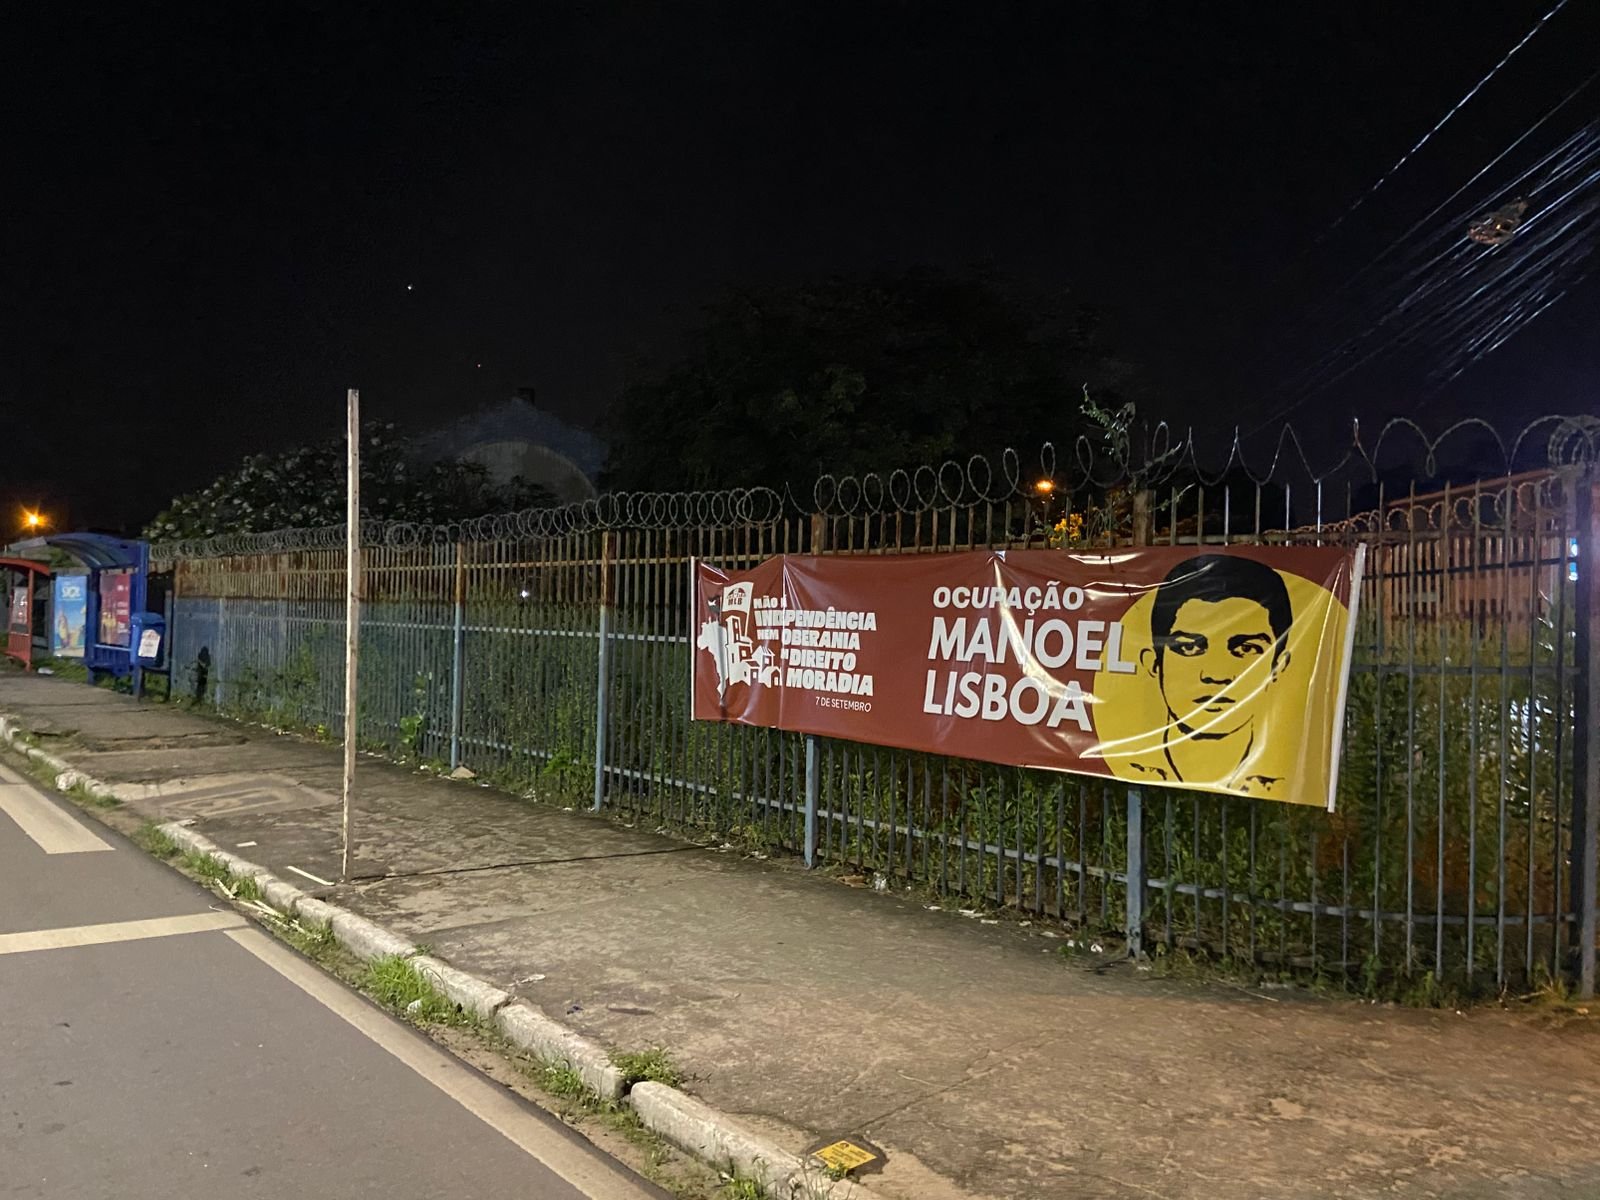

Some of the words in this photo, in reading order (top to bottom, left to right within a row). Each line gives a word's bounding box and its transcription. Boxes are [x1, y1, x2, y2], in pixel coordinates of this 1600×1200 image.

[753, 595, 778, 608] NÃO
[933, 581, 1084, 615] OCUPAÇÃO
[754, 606, 877, 631] INDPENDÊNCIA
[782, 629, 860, 650] OBERANIA
[927, 616, 1136, 673] MANOEL
[789, 649, 856, 671] DIREITO
[785, 669, 873, 697] MORADIA
[815, 696, 820, 706] 7
[820, 697, 831, 707] DE
[831, 698, 872, 712] SETEMBRO
[923, 669, 1093, 732] LISBOA
